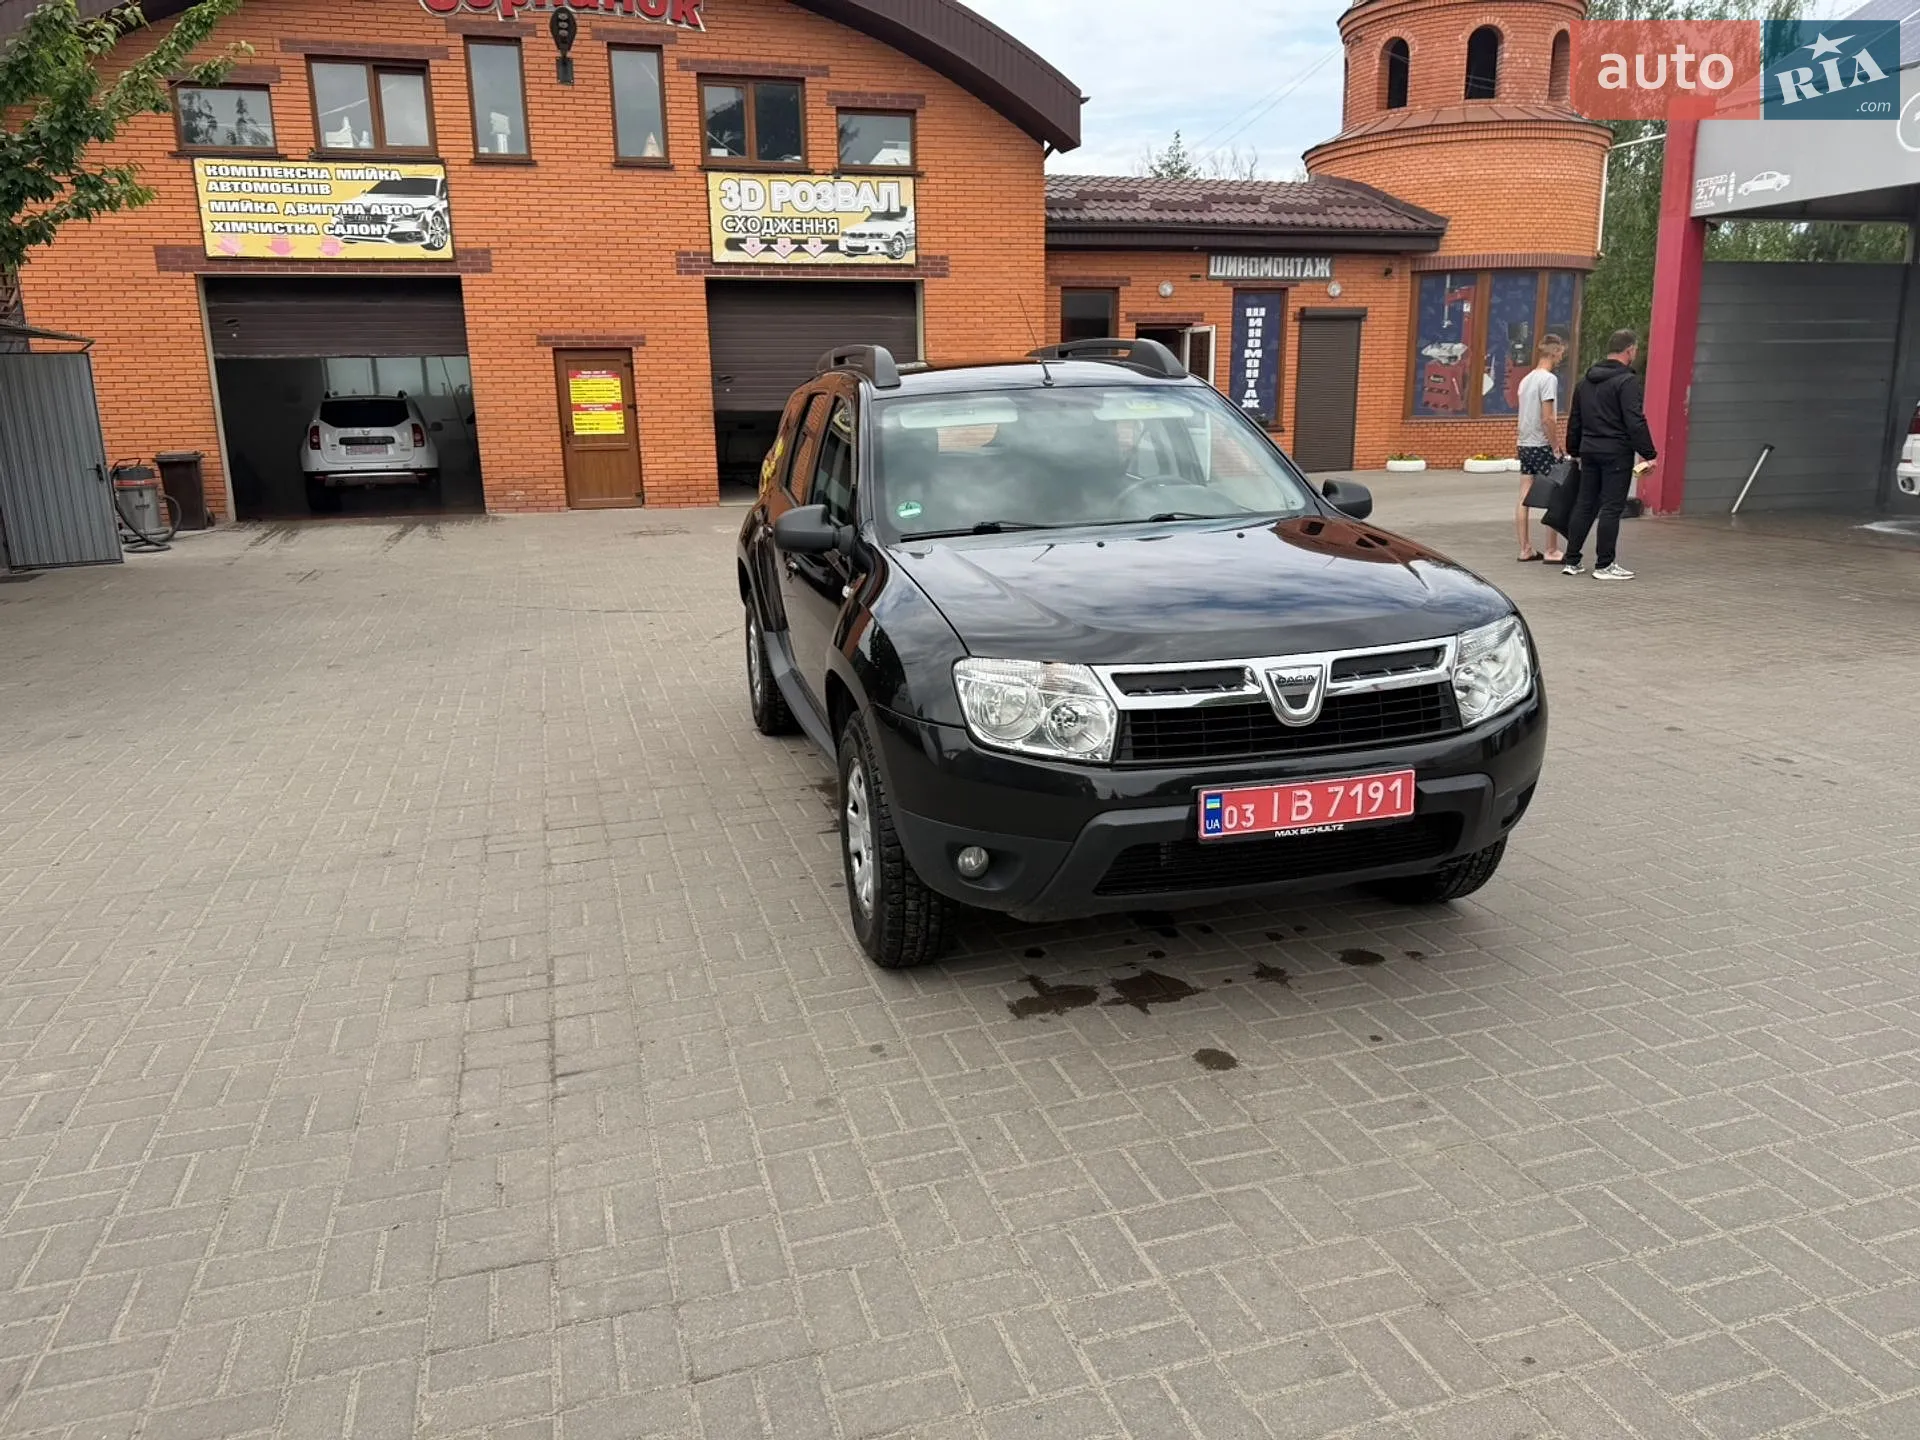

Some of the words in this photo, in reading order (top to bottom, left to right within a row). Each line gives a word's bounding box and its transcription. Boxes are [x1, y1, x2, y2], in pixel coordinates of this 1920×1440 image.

[204, 165, 332, 180] КОМПЛЕКСНА
[335, 167, 402, 180] МИЙКА
[206, 180, 332, 195] АВТОМОБІЛІВ
[720, 178, 767, 211] 3D
[769, 180, 901, 213] РОЗВАЛ
[208, 199, 279, 214] МИЙКА
[283, 202, 366, 216] ДВИГУНА
[370, 203, 414, 216] АВТО
[210, 220, 320, 235] ХІМЧИСТКА
[322, 223, 393, 237] САЛОНУ
[721, 215, 839, 237] СХОДЖЕННЯ
[1208, 255, 1332, 278] ШИНОМОНТАЖ
[1241, 307, 1266, 408] ШИНОМОНТАЖ
[1205, 817, 1221, 830] UA
[1224, 803, 1256, 829] 03
[1327, 777, 1404, 819] 7191
[1274, 829, 1299, 838] MAX
[1300, 824, 1345, 836] SCHULTZ
